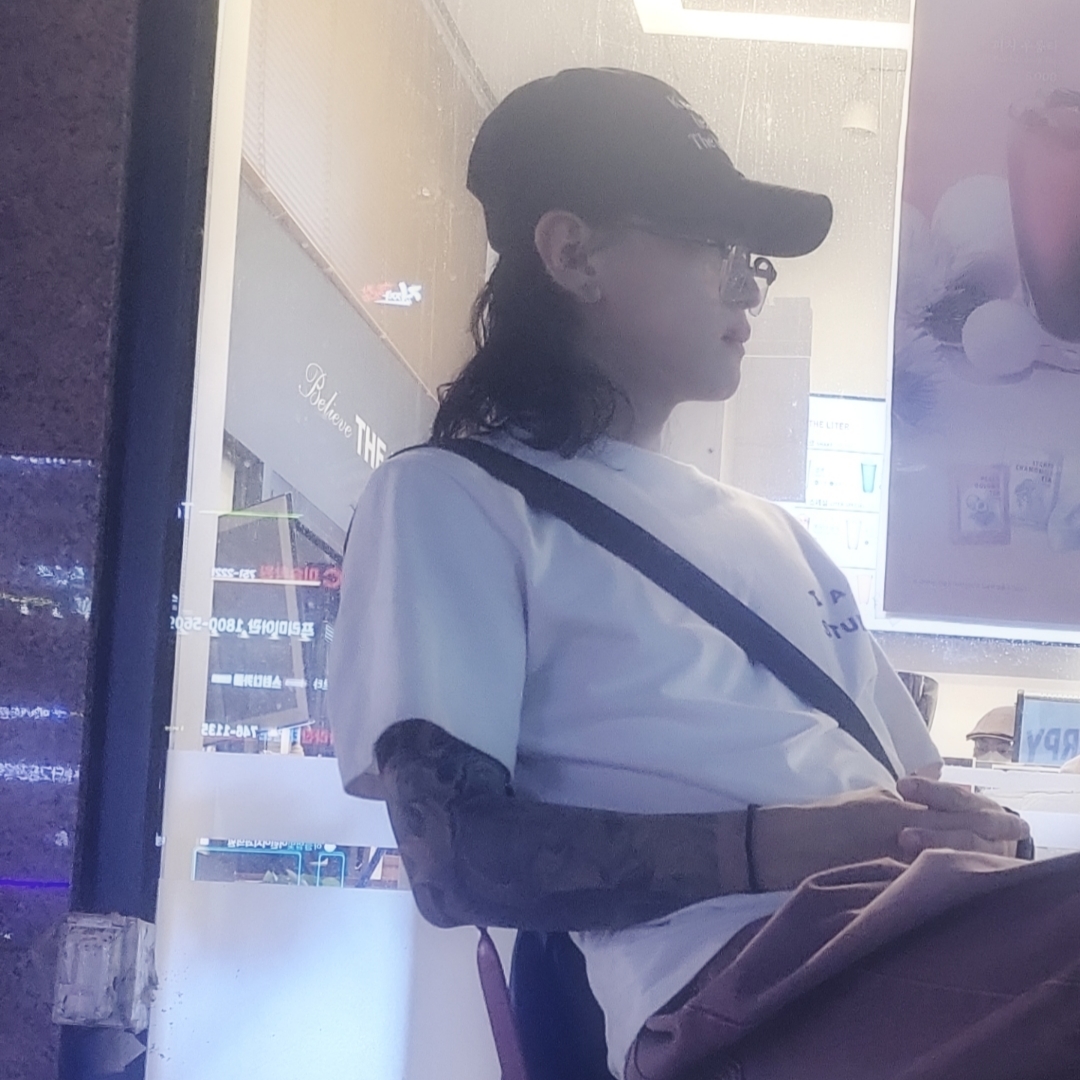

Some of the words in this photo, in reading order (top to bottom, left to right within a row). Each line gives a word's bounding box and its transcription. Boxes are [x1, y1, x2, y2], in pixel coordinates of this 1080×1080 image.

[298, 362, 353, 438] Believe
[354, 413, 388, 470] THE
[809, 419, 824, 429] THE
[826, 421, 850, 431] LITER
